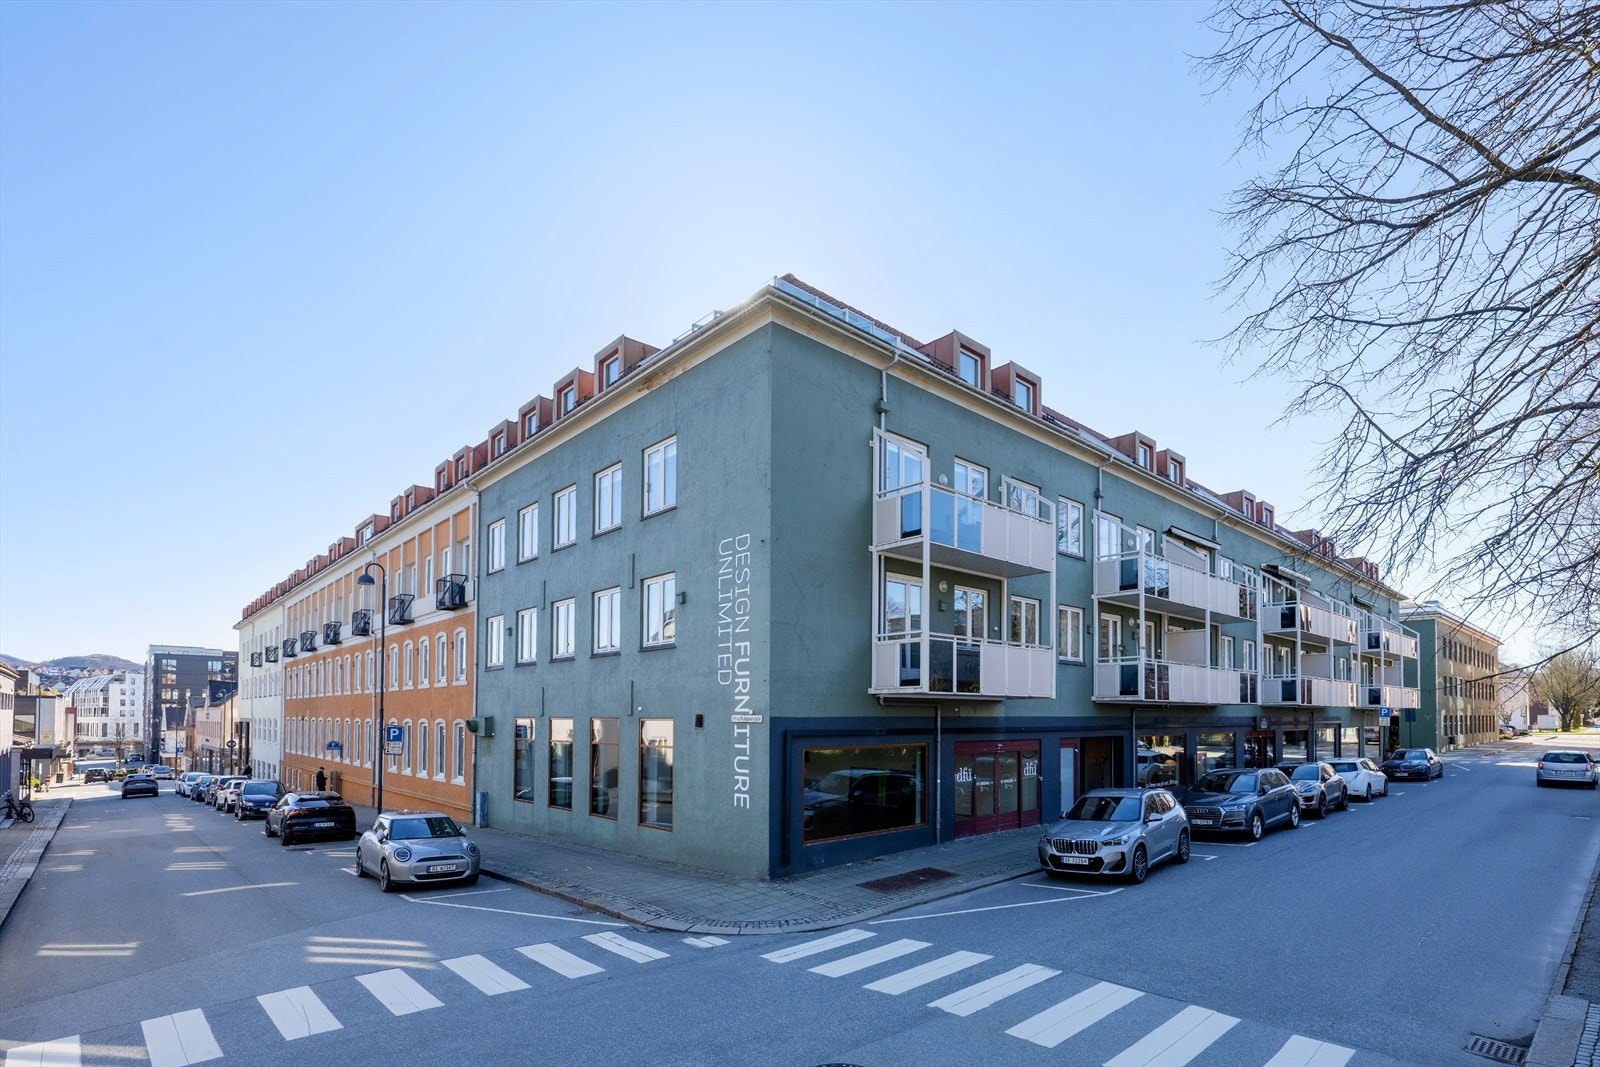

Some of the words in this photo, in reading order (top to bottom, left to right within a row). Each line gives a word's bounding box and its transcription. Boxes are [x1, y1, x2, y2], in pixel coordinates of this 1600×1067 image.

[717, 537, 733, 685] UNLIMITED
[735, 533, 750, 633] DESIGN
[390, 728, 399, 740] P
[734, 640, 750, 809] FURNITURE
[1381, 708, 1388, 716] P
